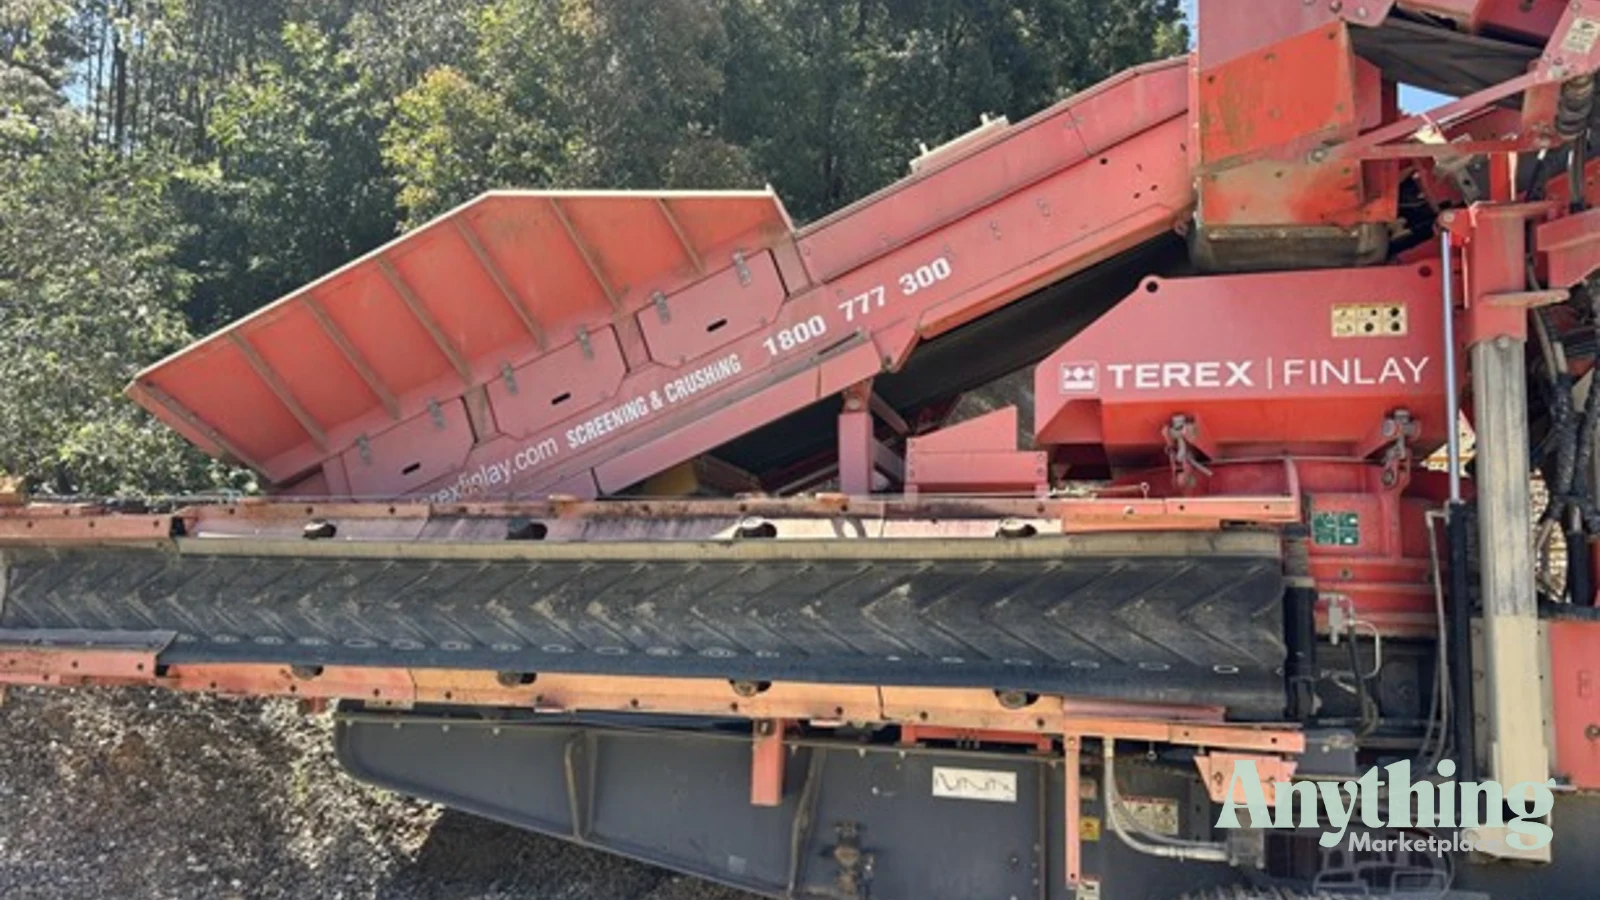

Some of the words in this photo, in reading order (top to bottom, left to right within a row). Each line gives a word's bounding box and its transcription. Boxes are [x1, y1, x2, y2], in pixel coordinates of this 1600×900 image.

[566, 395, 649, 449] SCREENING
[650, 389, 663, 411] &
[665, 353, 742, 403] CRUSHING
[762, 315, 827, 356] 1800
[838, 286, 887, 322] 777
[898, 256, 951, 295] 300
[1107, 361, 1255, 388] TEREX
[1284, 356, 1429, 386] FINLAY
